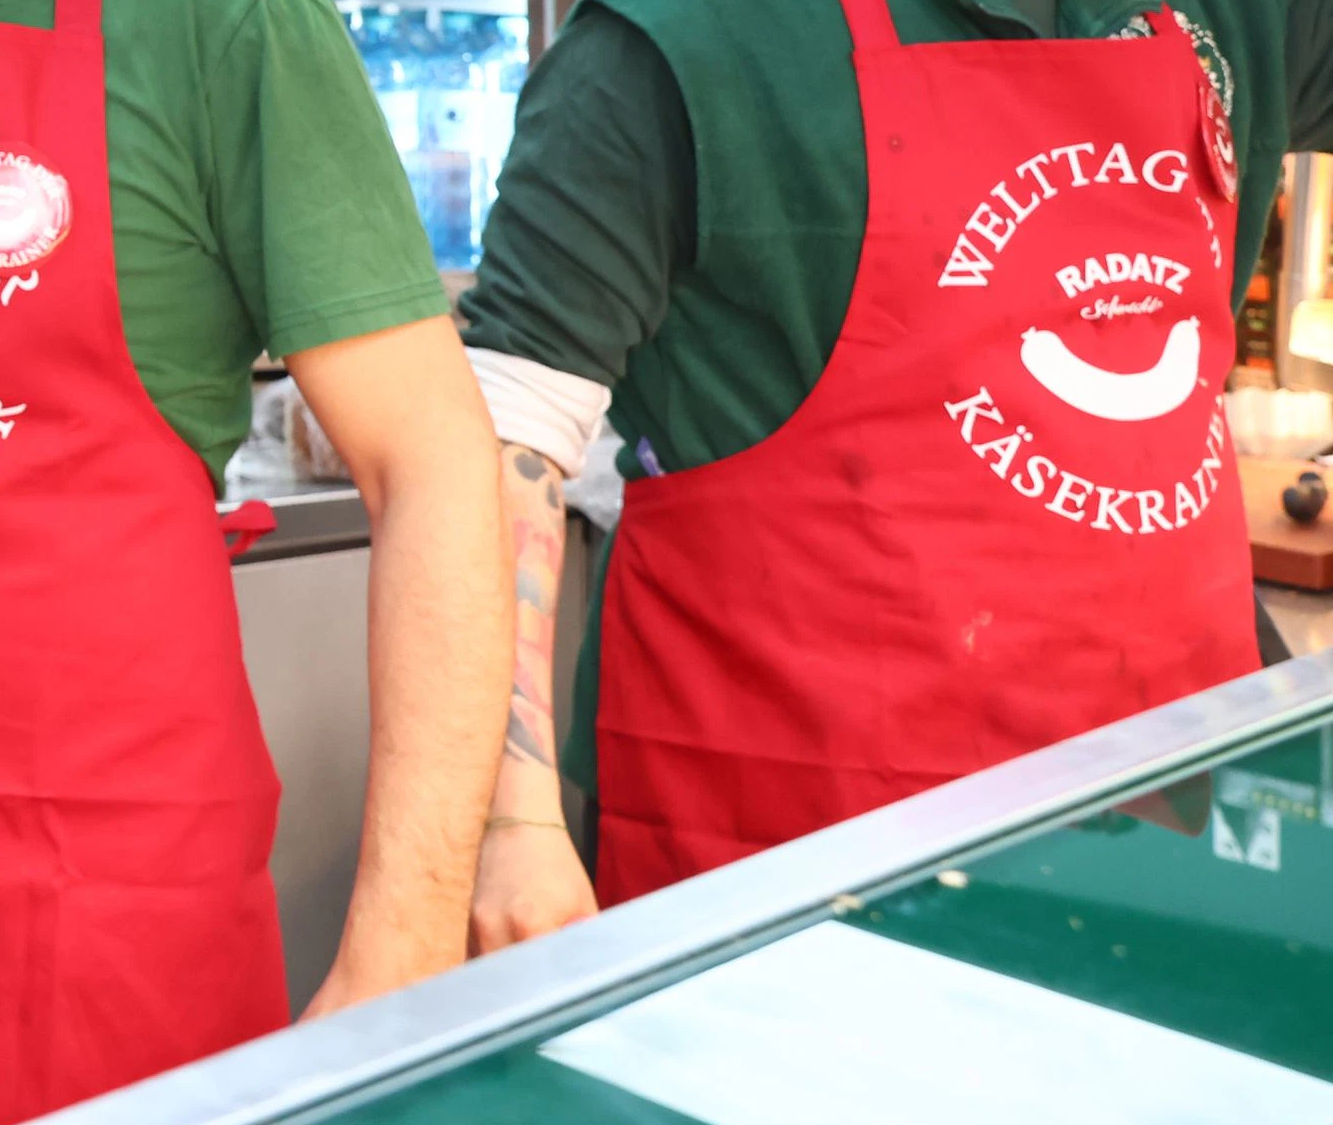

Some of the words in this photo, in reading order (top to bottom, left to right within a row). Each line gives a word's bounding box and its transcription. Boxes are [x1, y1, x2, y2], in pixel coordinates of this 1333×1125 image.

[938, 142, 1189, 287] WELTTAG
[1055, 253, 1191, 299] RADATZ
[943, 386, 1224, 536] KÄSEKRAINE
